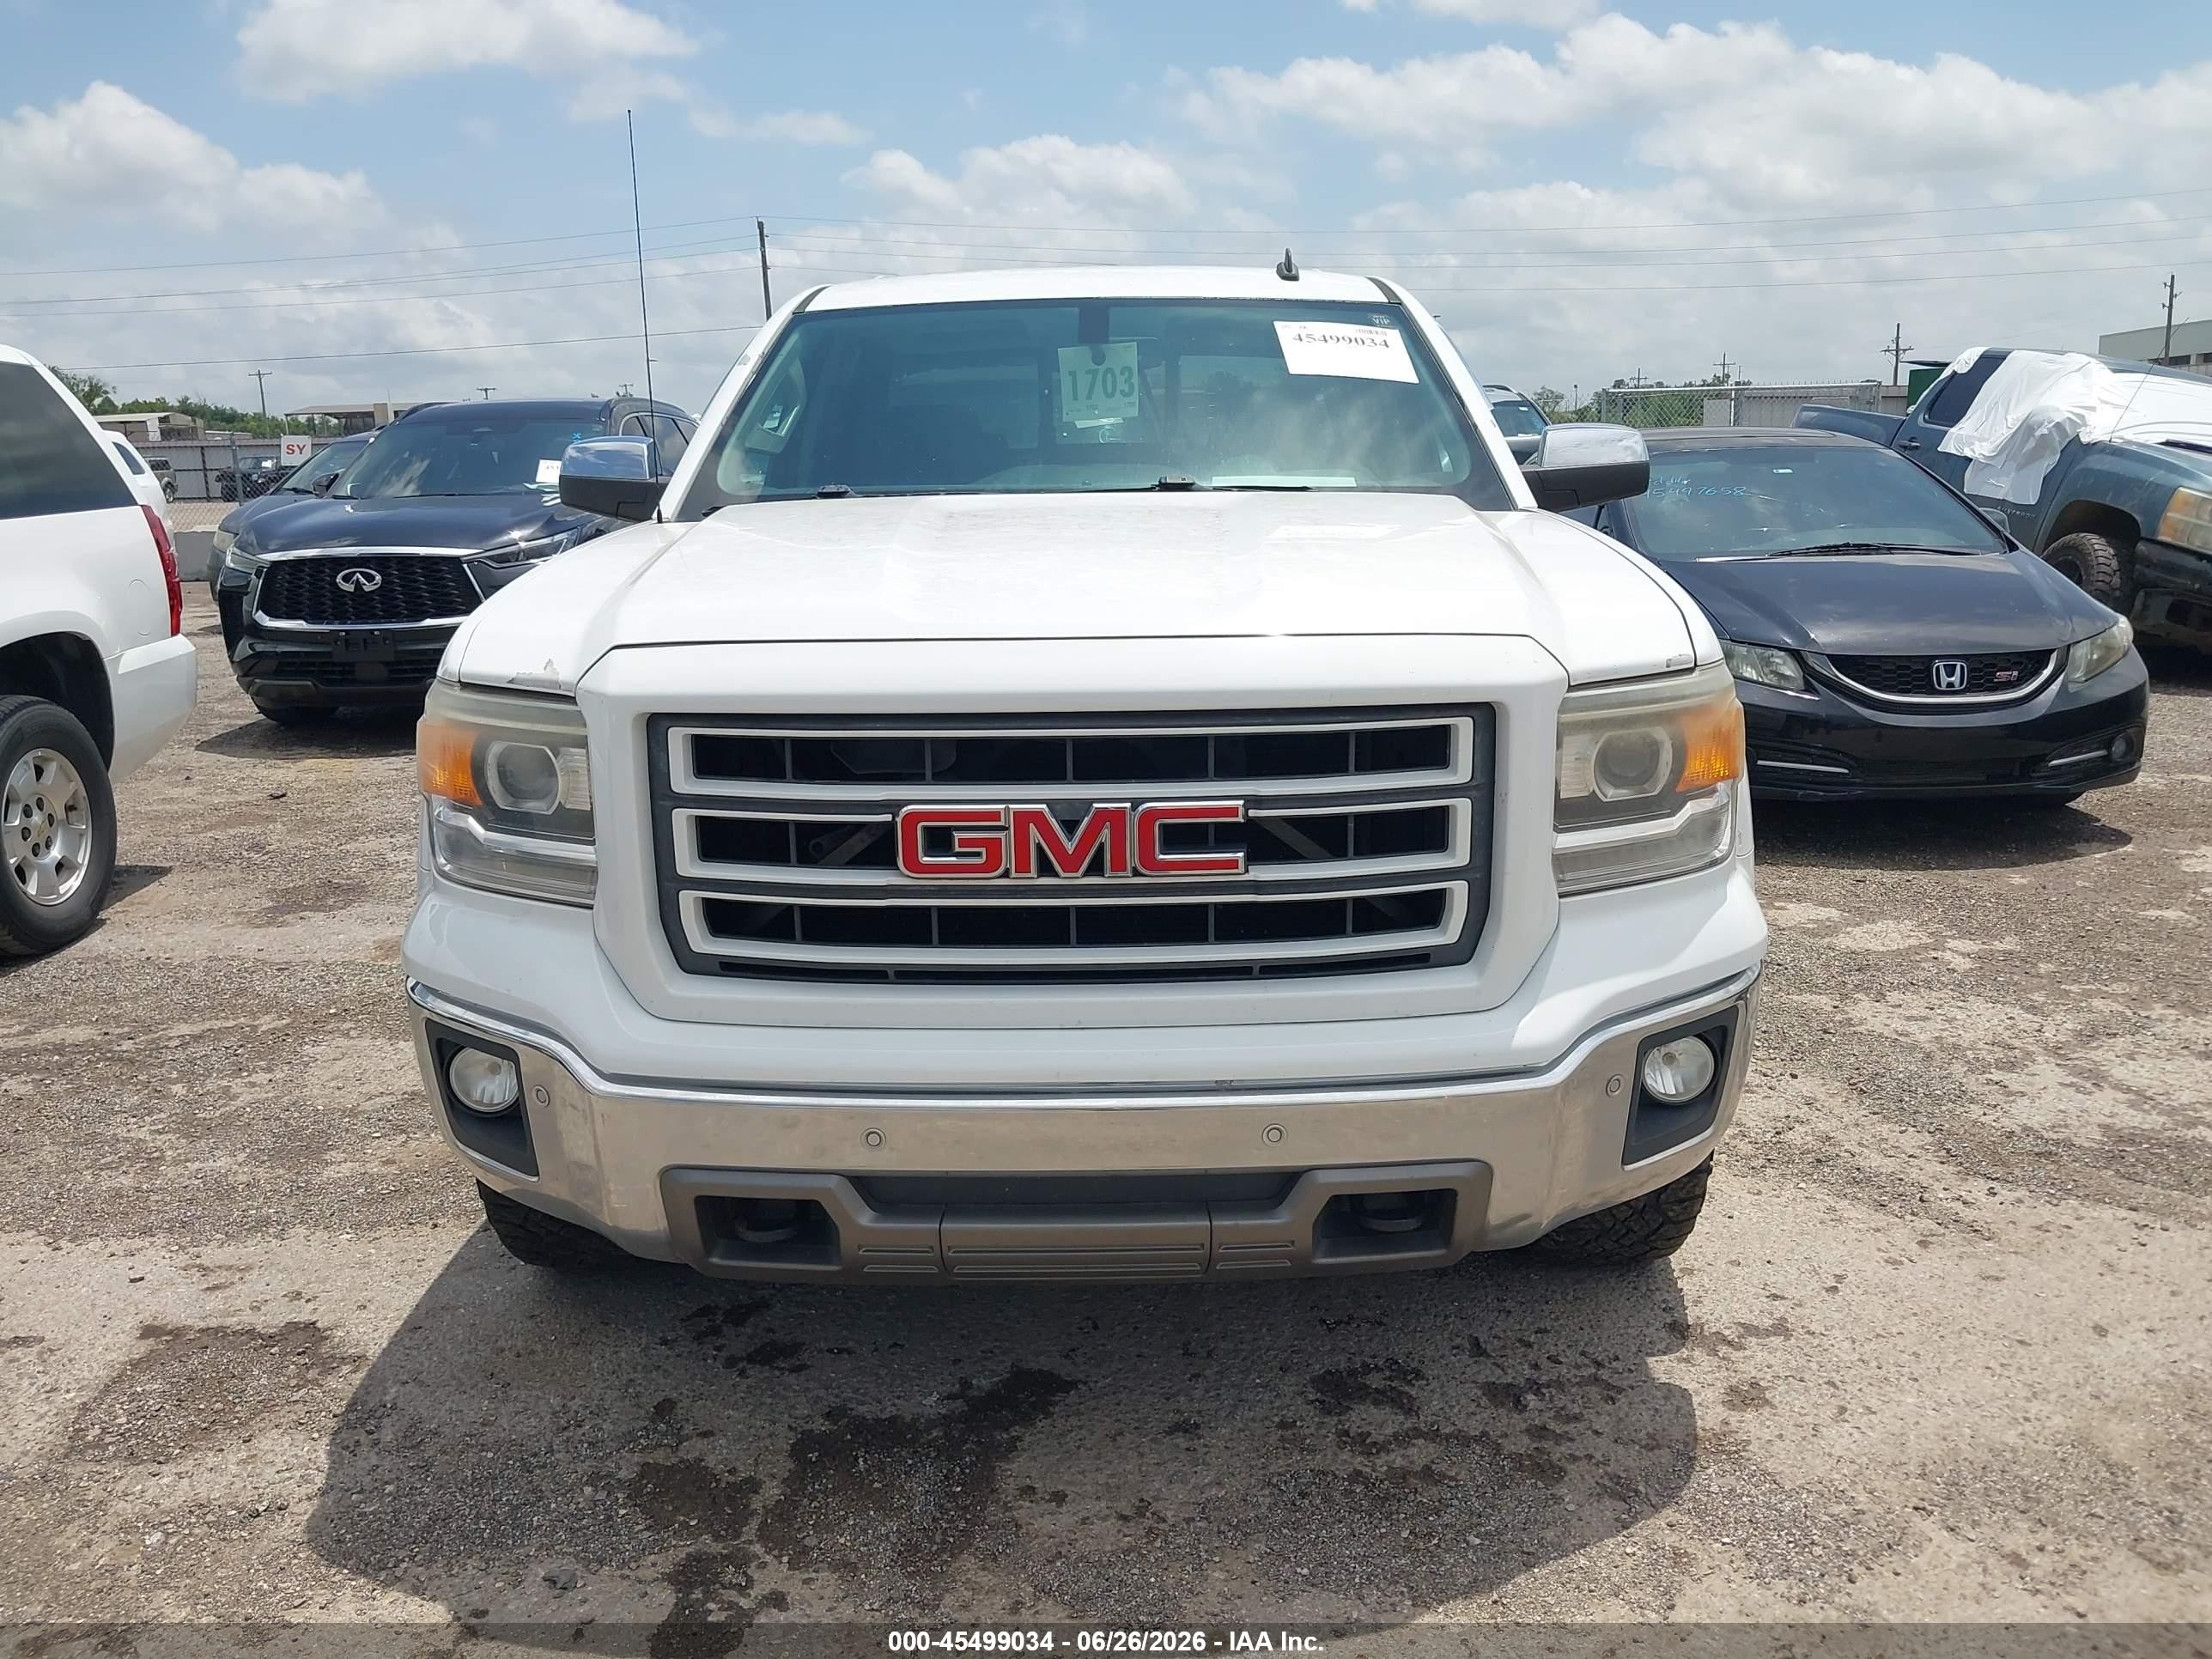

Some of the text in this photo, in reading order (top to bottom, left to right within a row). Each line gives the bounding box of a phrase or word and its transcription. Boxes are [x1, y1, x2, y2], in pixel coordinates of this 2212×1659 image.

[1292, 332, 1391, 349] 45499034
[1067, 366, 1135, 401] 1703
[286, 443, 307, 455] SY
[1994, 671, 2019, 682] Si
[898, 800, 1245, 879] GMC
